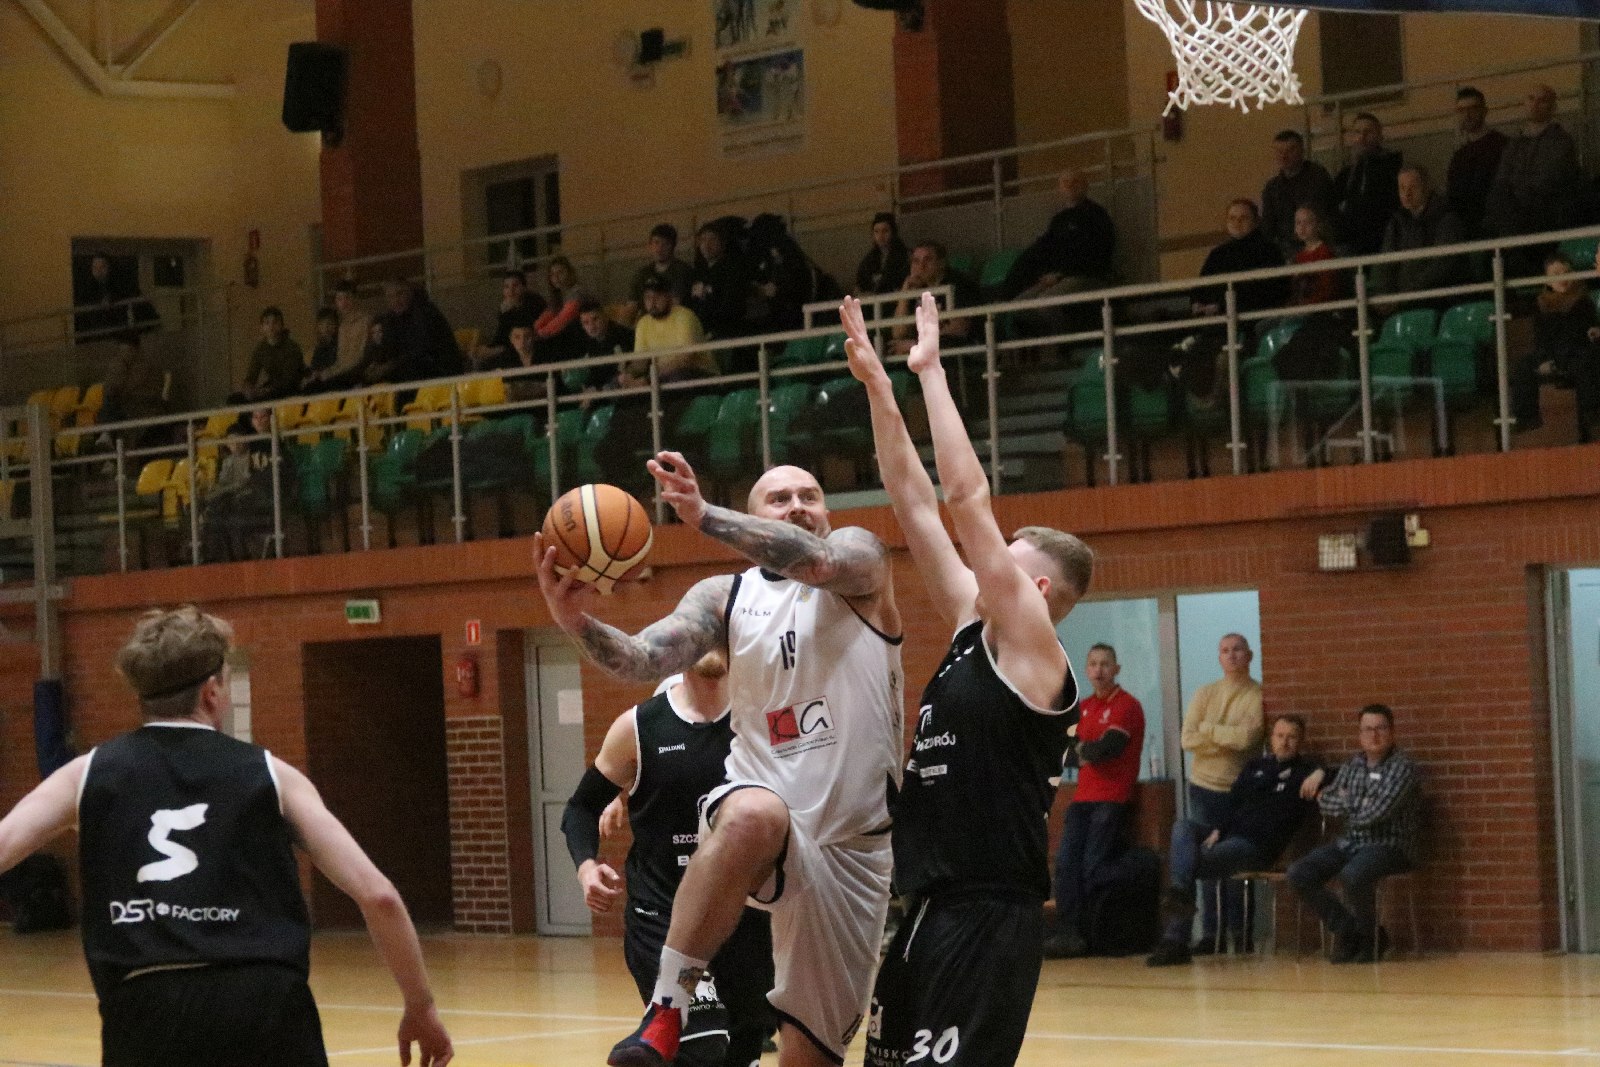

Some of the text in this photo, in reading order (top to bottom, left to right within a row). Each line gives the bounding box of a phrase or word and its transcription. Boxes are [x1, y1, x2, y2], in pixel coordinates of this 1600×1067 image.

[658, 743, 686, 754] SPALDING
[171, 904, 240, 922] FACTORY
[905, 1025, 960, 1064] 30
